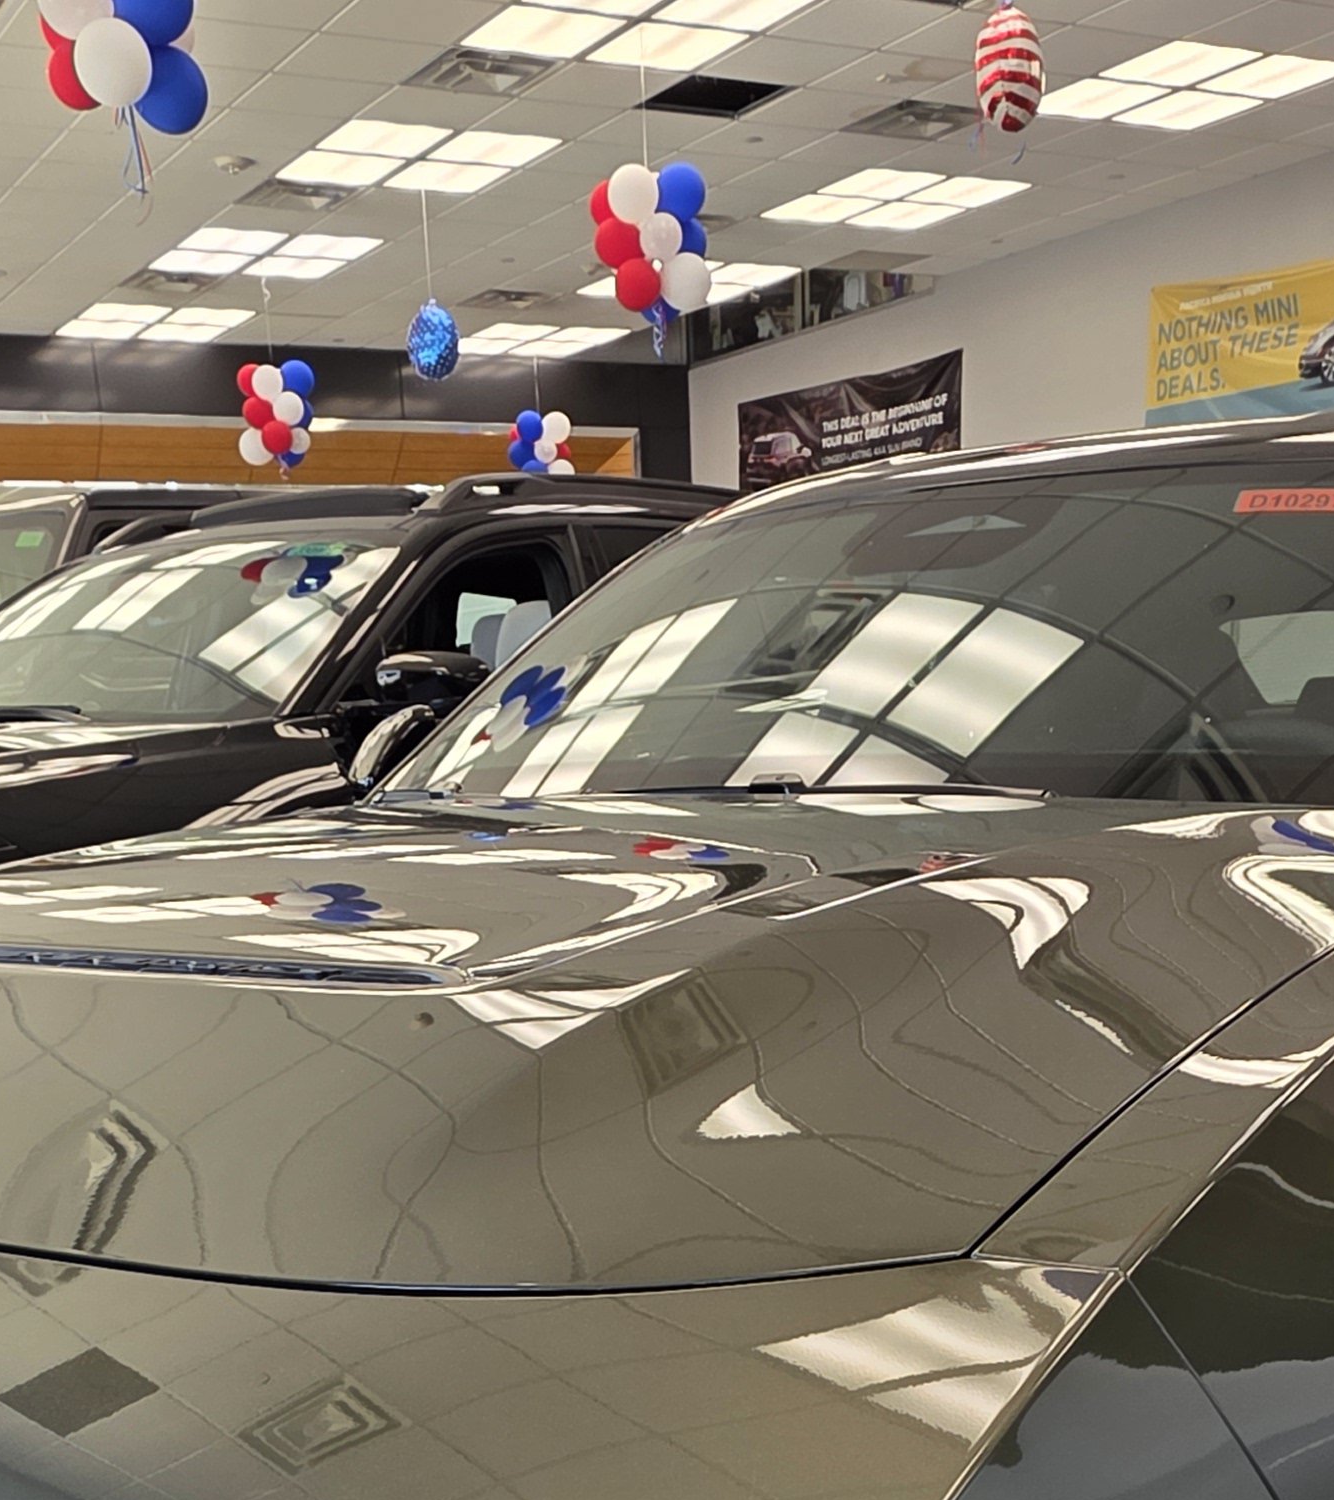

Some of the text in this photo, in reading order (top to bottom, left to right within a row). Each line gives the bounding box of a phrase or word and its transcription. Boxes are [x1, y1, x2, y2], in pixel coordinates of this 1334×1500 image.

[1158, 306, 1248, 346] NOTHING
[1254, 293, 1299, 326] MINI
[1156, 323, 1299, 375] ABOUT THESE
[1156, 368, 1226, 401] DEALS.
[821, 412, 944, 449] YOUR NEXT GREAT ADVENTURE
[822, 419, 839, 433] THIS
[840, 415, 860, 429] DEAL
[861, 412, 870, 426] IS
[871, 409, 887, 422] THE
[933, 392, 948, 408] OF
